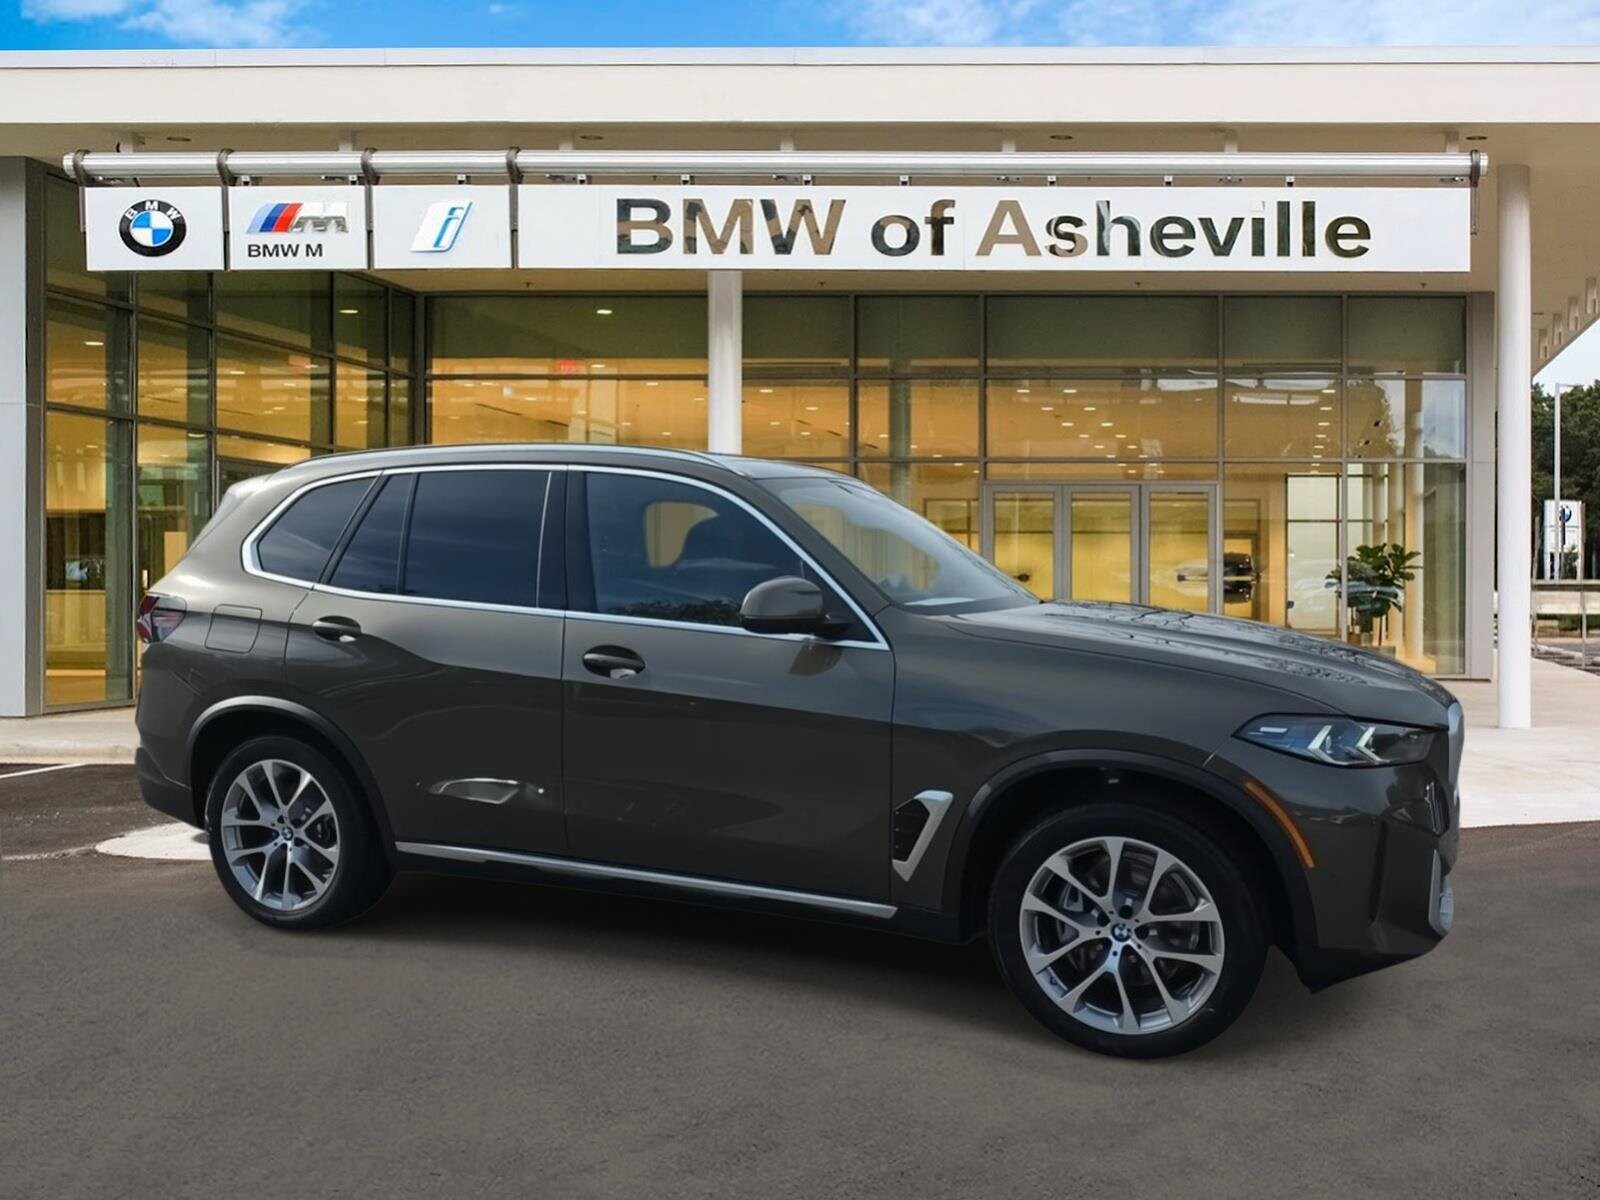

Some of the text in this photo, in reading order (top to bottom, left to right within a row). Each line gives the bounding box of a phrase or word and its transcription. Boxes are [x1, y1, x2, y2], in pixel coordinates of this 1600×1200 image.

[616, 198, 1372, 257] BMW of Asheville
[247, 244, 323, 258] BMW M
